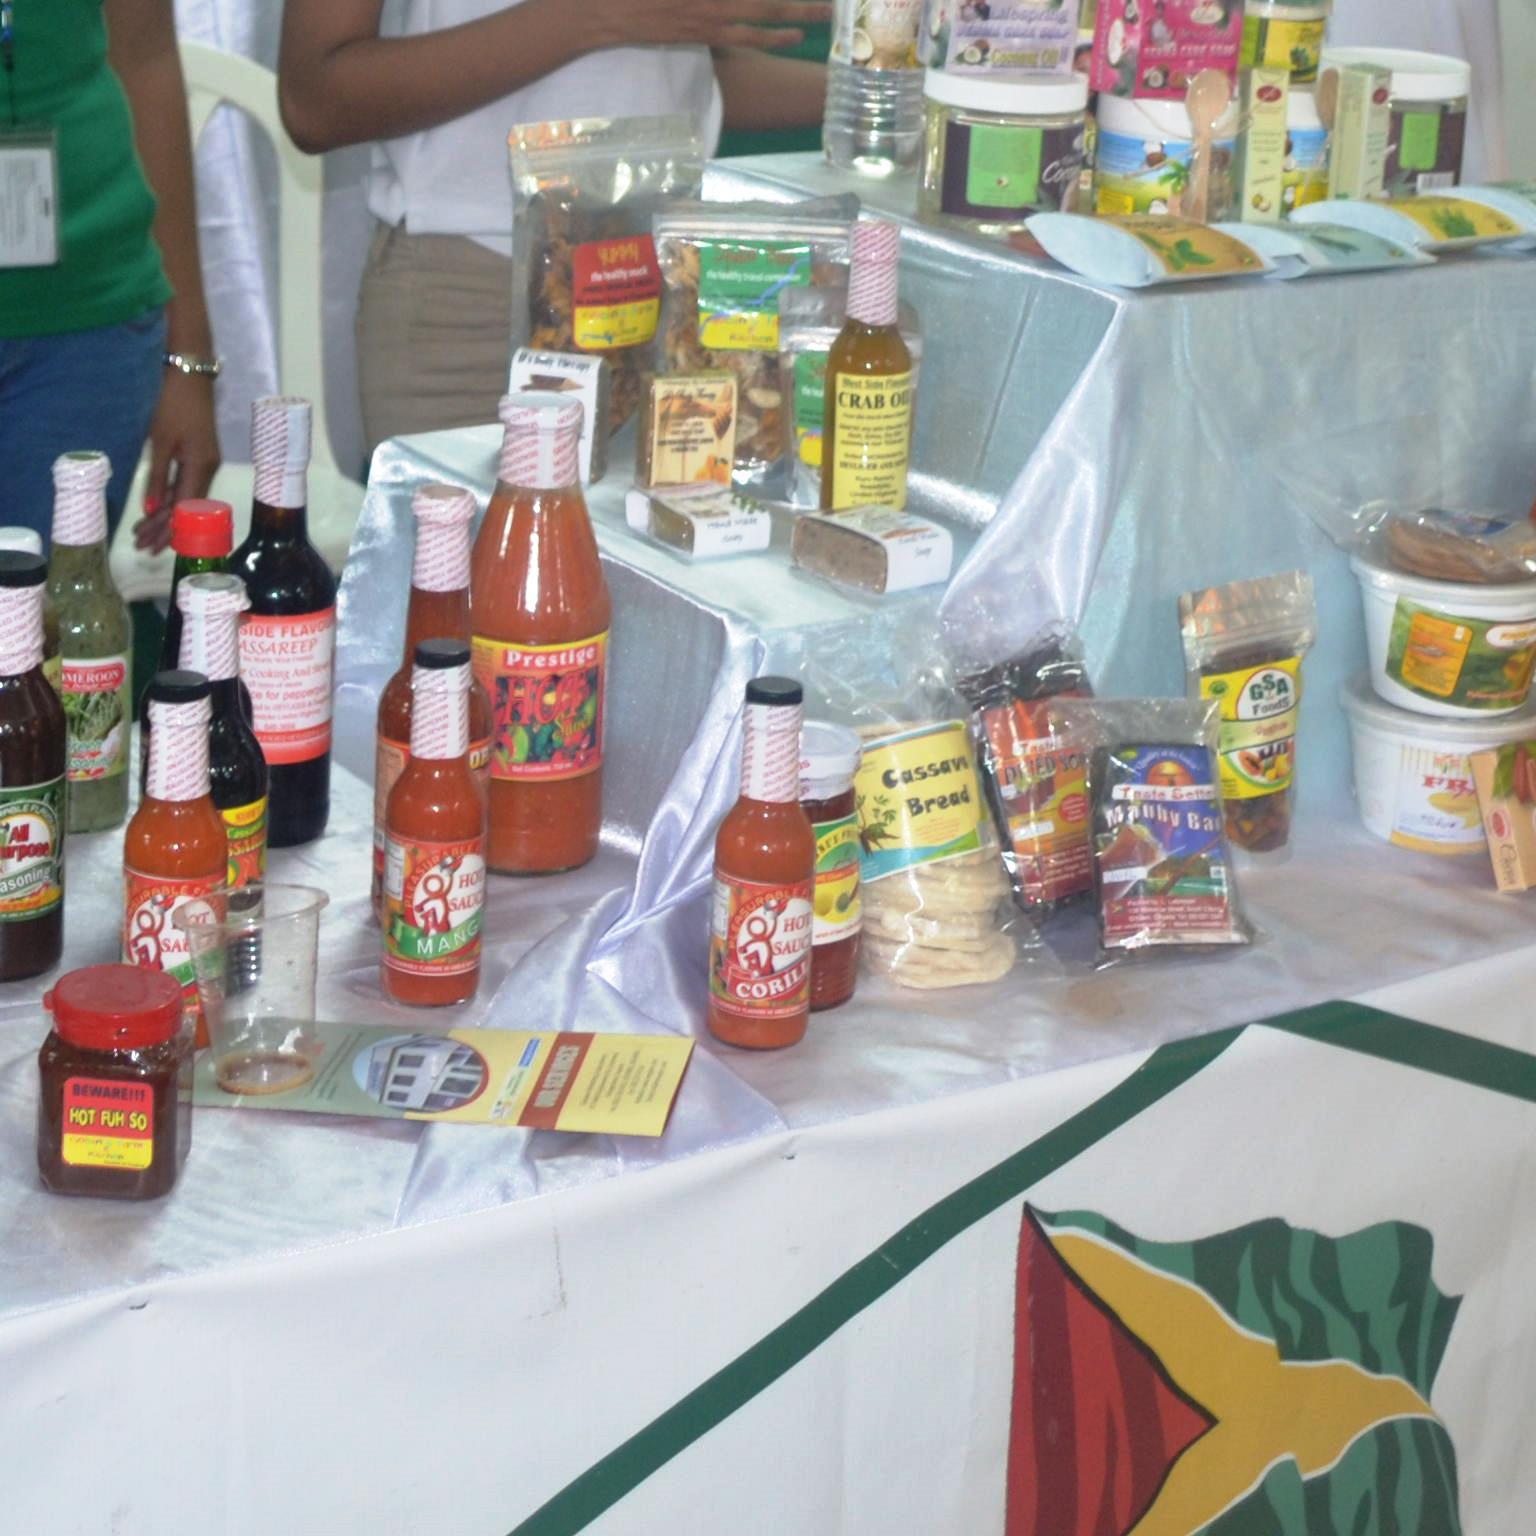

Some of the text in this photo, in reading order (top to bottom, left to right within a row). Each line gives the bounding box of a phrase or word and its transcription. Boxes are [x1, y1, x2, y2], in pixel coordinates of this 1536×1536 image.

[838, 390, 885, 410] CRAB
[280, 619, 333, 638] FLAVO
[507, 645, 596, 668] Prestige
[503, 669, 590, 726] HOT
[1249, 673, 1290, 701] GSA
[906, 789, 971, 818] Bread
[9, 823, 30, 843] All
[69, 1106, 97, 1127] HOT
[128, 1110, 148, 1132] SO
